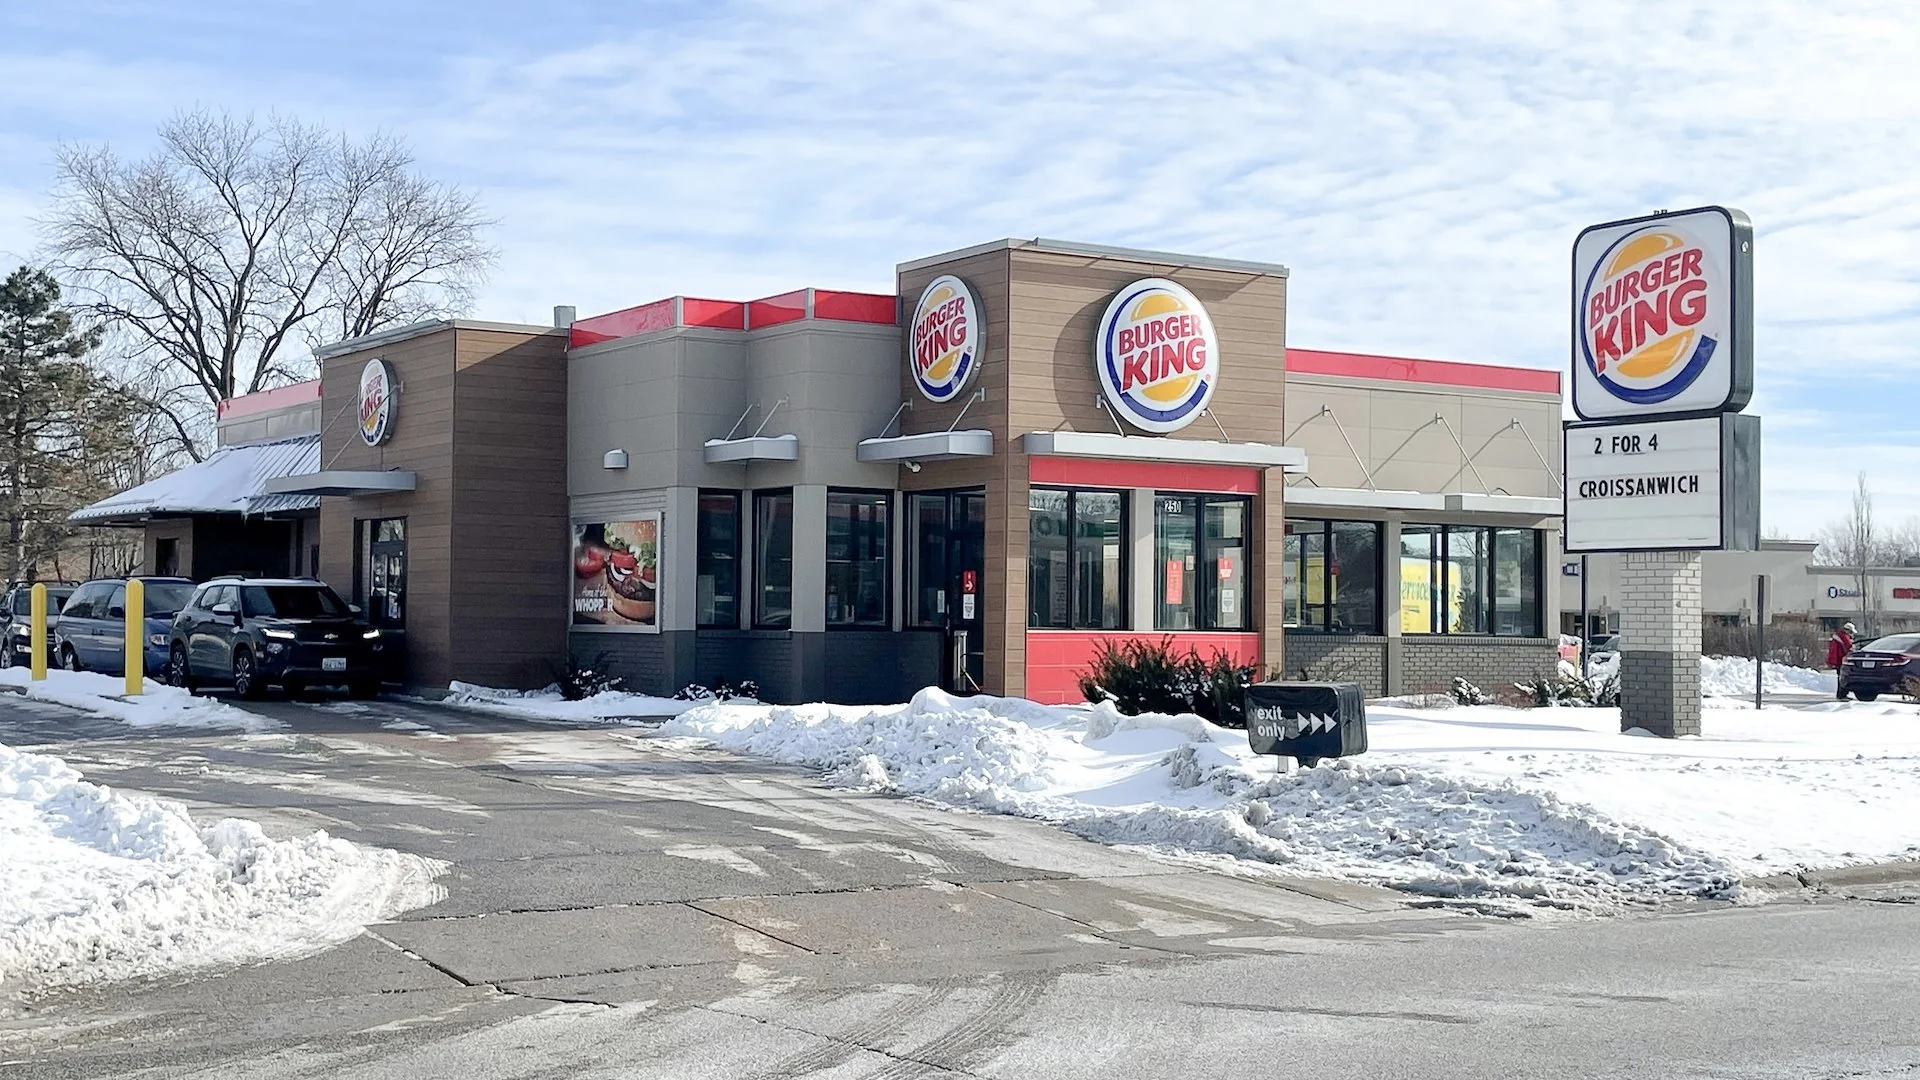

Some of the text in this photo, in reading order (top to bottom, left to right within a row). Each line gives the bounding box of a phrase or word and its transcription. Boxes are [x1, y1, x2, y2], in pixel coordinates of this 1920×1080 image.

[1590, 248, 1703, 330] BURGER
[916, 296, 965, 348] BURGER
[1119, 314, 1203, 356] BURGER
[1594, 279, 1708, 375] KING
[918, 316, 967, 378] KING
[1122, 337, 1206, 391] KING
[1594, 433, 1658, 455] 2 FOR 4
[1579, 475, 1699, 498] CROISSANWICH
[575, 598, 614, 612] WHOPPR
[1257, 705, 1283, 720] exit
[1257, 722, 1286, 742] only
